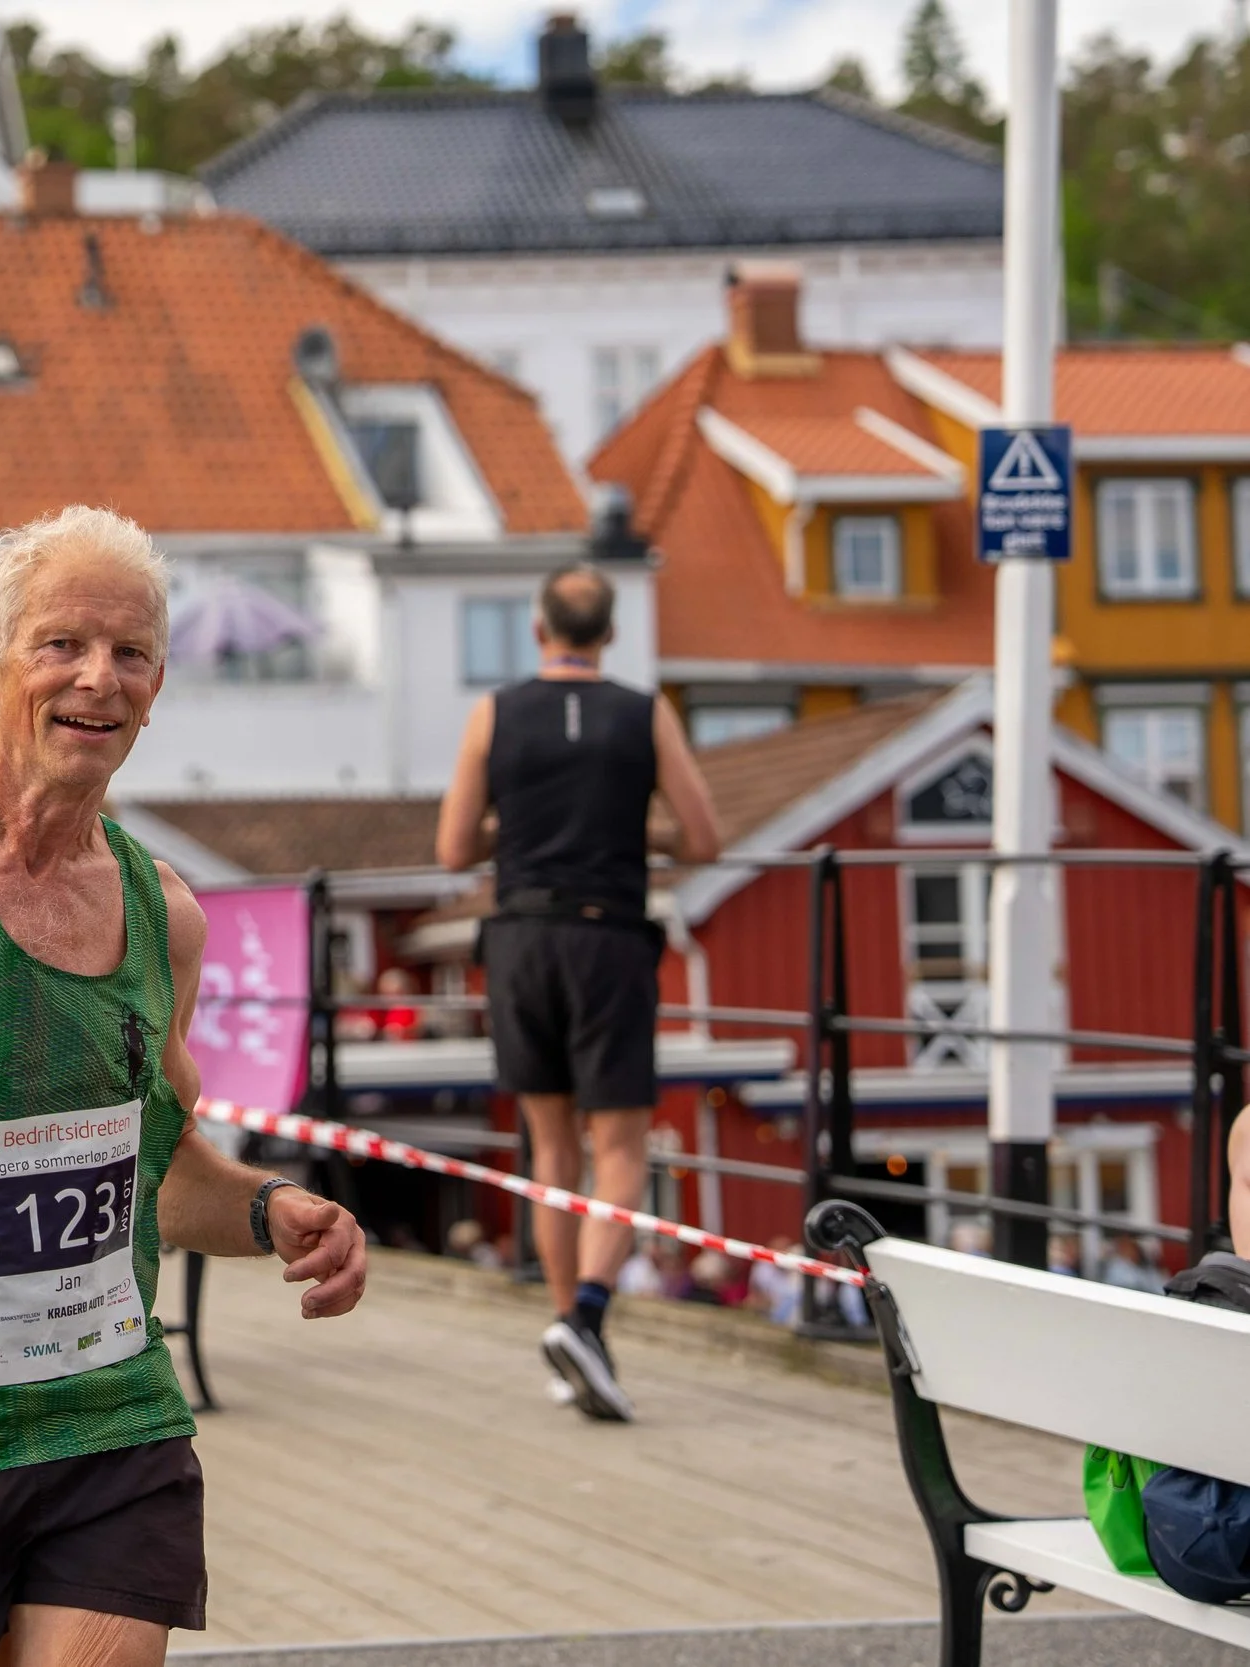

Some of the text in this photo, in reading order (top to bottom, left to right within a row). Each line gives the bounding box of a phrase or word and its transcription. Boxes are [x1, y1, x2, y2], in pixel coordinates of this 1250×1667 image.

[4, 1116, 131, 1147] Bedriftsidretten
[34, 1150, 108, 1170] sommerløp
[111, 1140, 131, 1158] 2026
[119, 1177, 132, 1233] 10 KM
[55, 1275, 81, 1292] Jan
[47, 1295, 105, 1320] KRAGERØ AUTO
[23, 1342, 62, 1358] SWML
